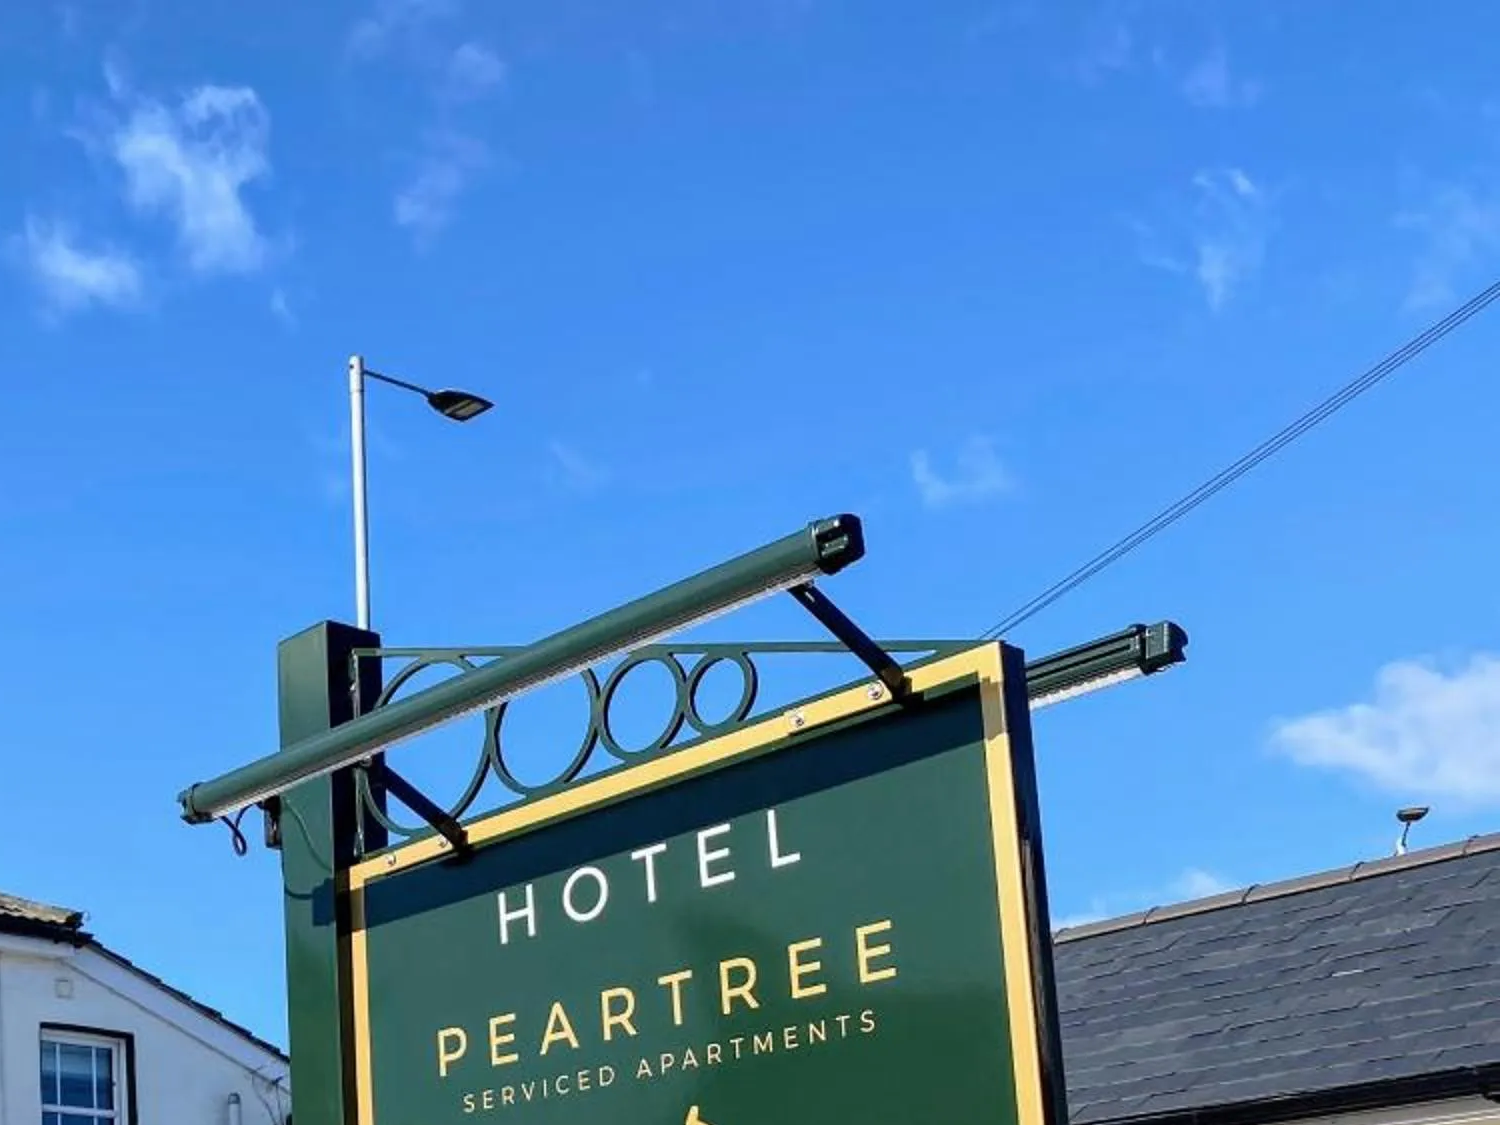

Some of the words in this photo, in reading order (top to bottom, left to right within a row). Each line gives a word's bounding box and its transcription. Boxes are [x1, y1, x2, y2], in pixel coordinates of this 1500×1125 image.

[499, 809, 801, 945] HOTEL
[436, 919, 898, 1077] PEARTREE
[463, 1065, 616, 1114] SERVICED
[636, 1009, 878, 1079] APARTMENTS
